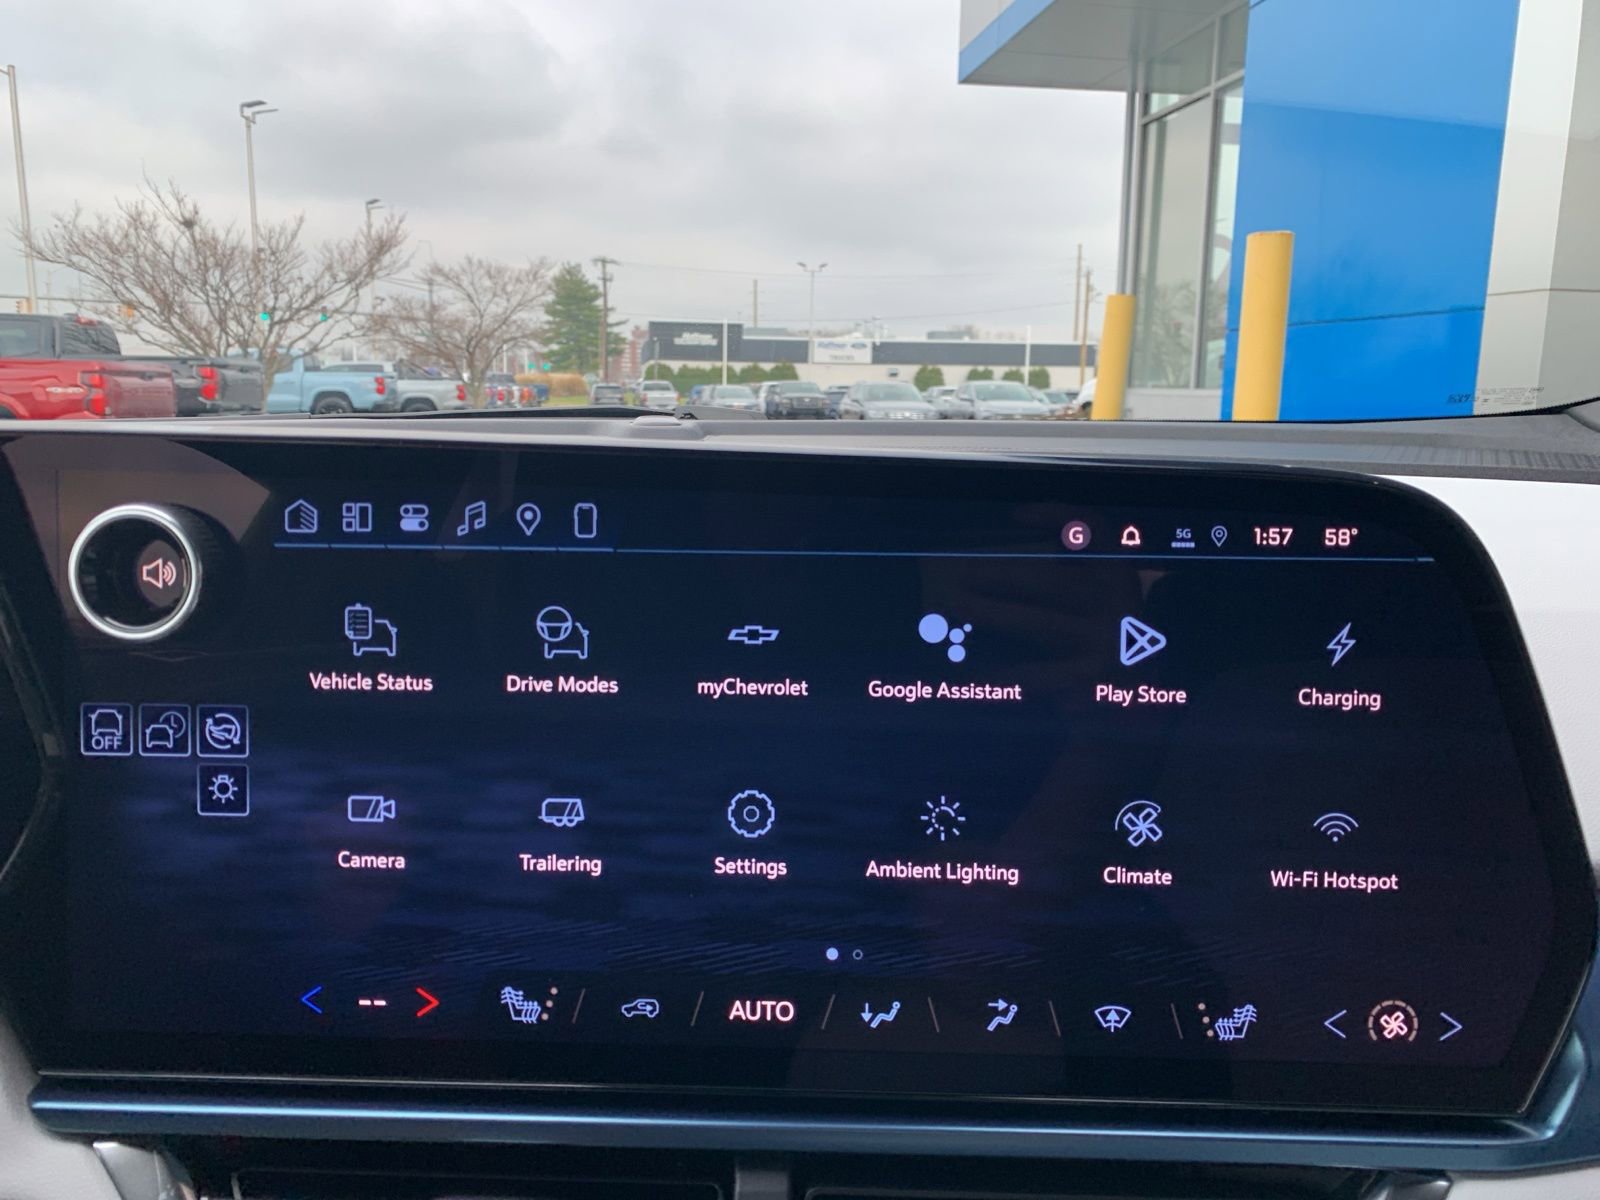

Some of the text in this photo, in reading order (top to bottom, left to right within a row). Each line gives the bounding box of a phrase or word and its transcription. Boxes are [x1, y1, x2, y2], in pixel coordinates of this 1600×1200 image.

[1068, 526, 1084, 544] G
[1175, 528, 1192, 539] 5G
[1253, 527, 1293, 546] 1:57
[309, 671, 434, 691] Vehicle Status
[506, 674, 619, 694] Drive Modes
[697, 677, 809, 699] myChevrolet
[868, 680, 1022, 703] Google Assistant
[1096, 684, 1188, 707] Play Store
[1298, 687, 1382, 712] Charging
[91, 735, 122, 750] OFF
[337, 850, 406, 869] Camera
[519, 853, 603, 877] Trailering
[714, 856, 788, 880] Settings
[865, 860, 1019, 886] Ambient Lighting
[1103, 866, 1173, 885] Climate
[1270, 870, 1399, 894] Wi-Fi Hotspot
[728, 999, 795, 1022] AUTO
